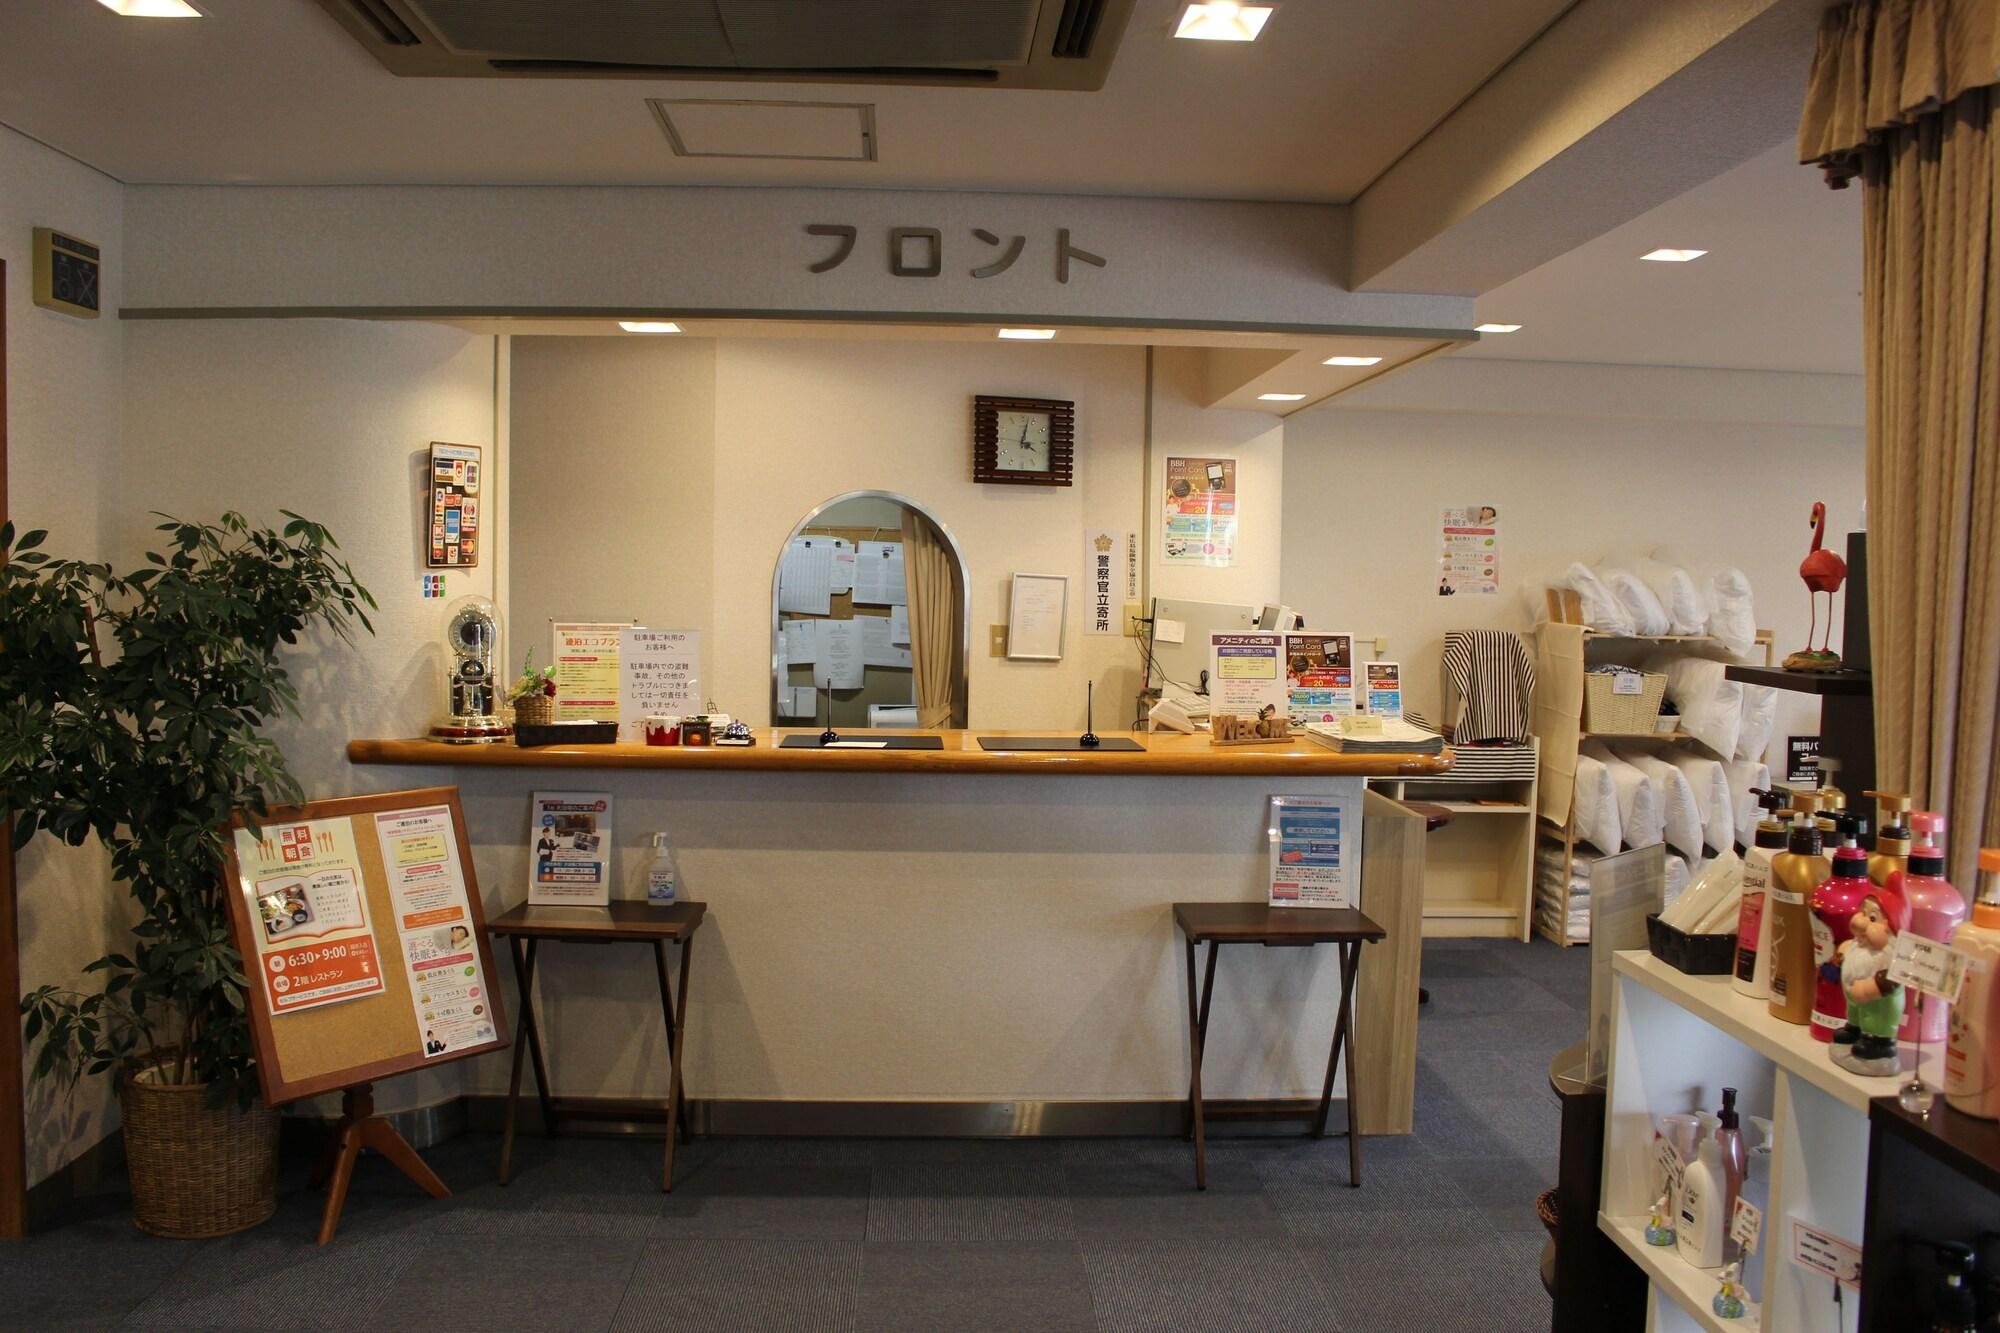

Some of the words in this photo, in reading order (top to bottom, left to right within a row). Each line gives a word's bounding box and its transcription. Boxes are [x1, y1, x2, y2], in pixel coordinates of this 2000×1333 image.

[807, 223, 1106, 284] フロント
[1096, 555, 1110, 631] 警察官立寄所
[645, 643, 675, 651] お客様へ
[634, 672, 685, 680] 事故、その他の
[631, 691, 688, 700] しては一切責任を
[641, 701, 679, 709] 負いません
[282, 829, 308, 842] 無料
[286, 845, 312, 859] 朝食
[288, 951, 314, 967] 6:30
[322, 945, 347, 960] 9:00
[293, 975, 309, 988] 2階
[311, 969, 344, 983] レストラン
